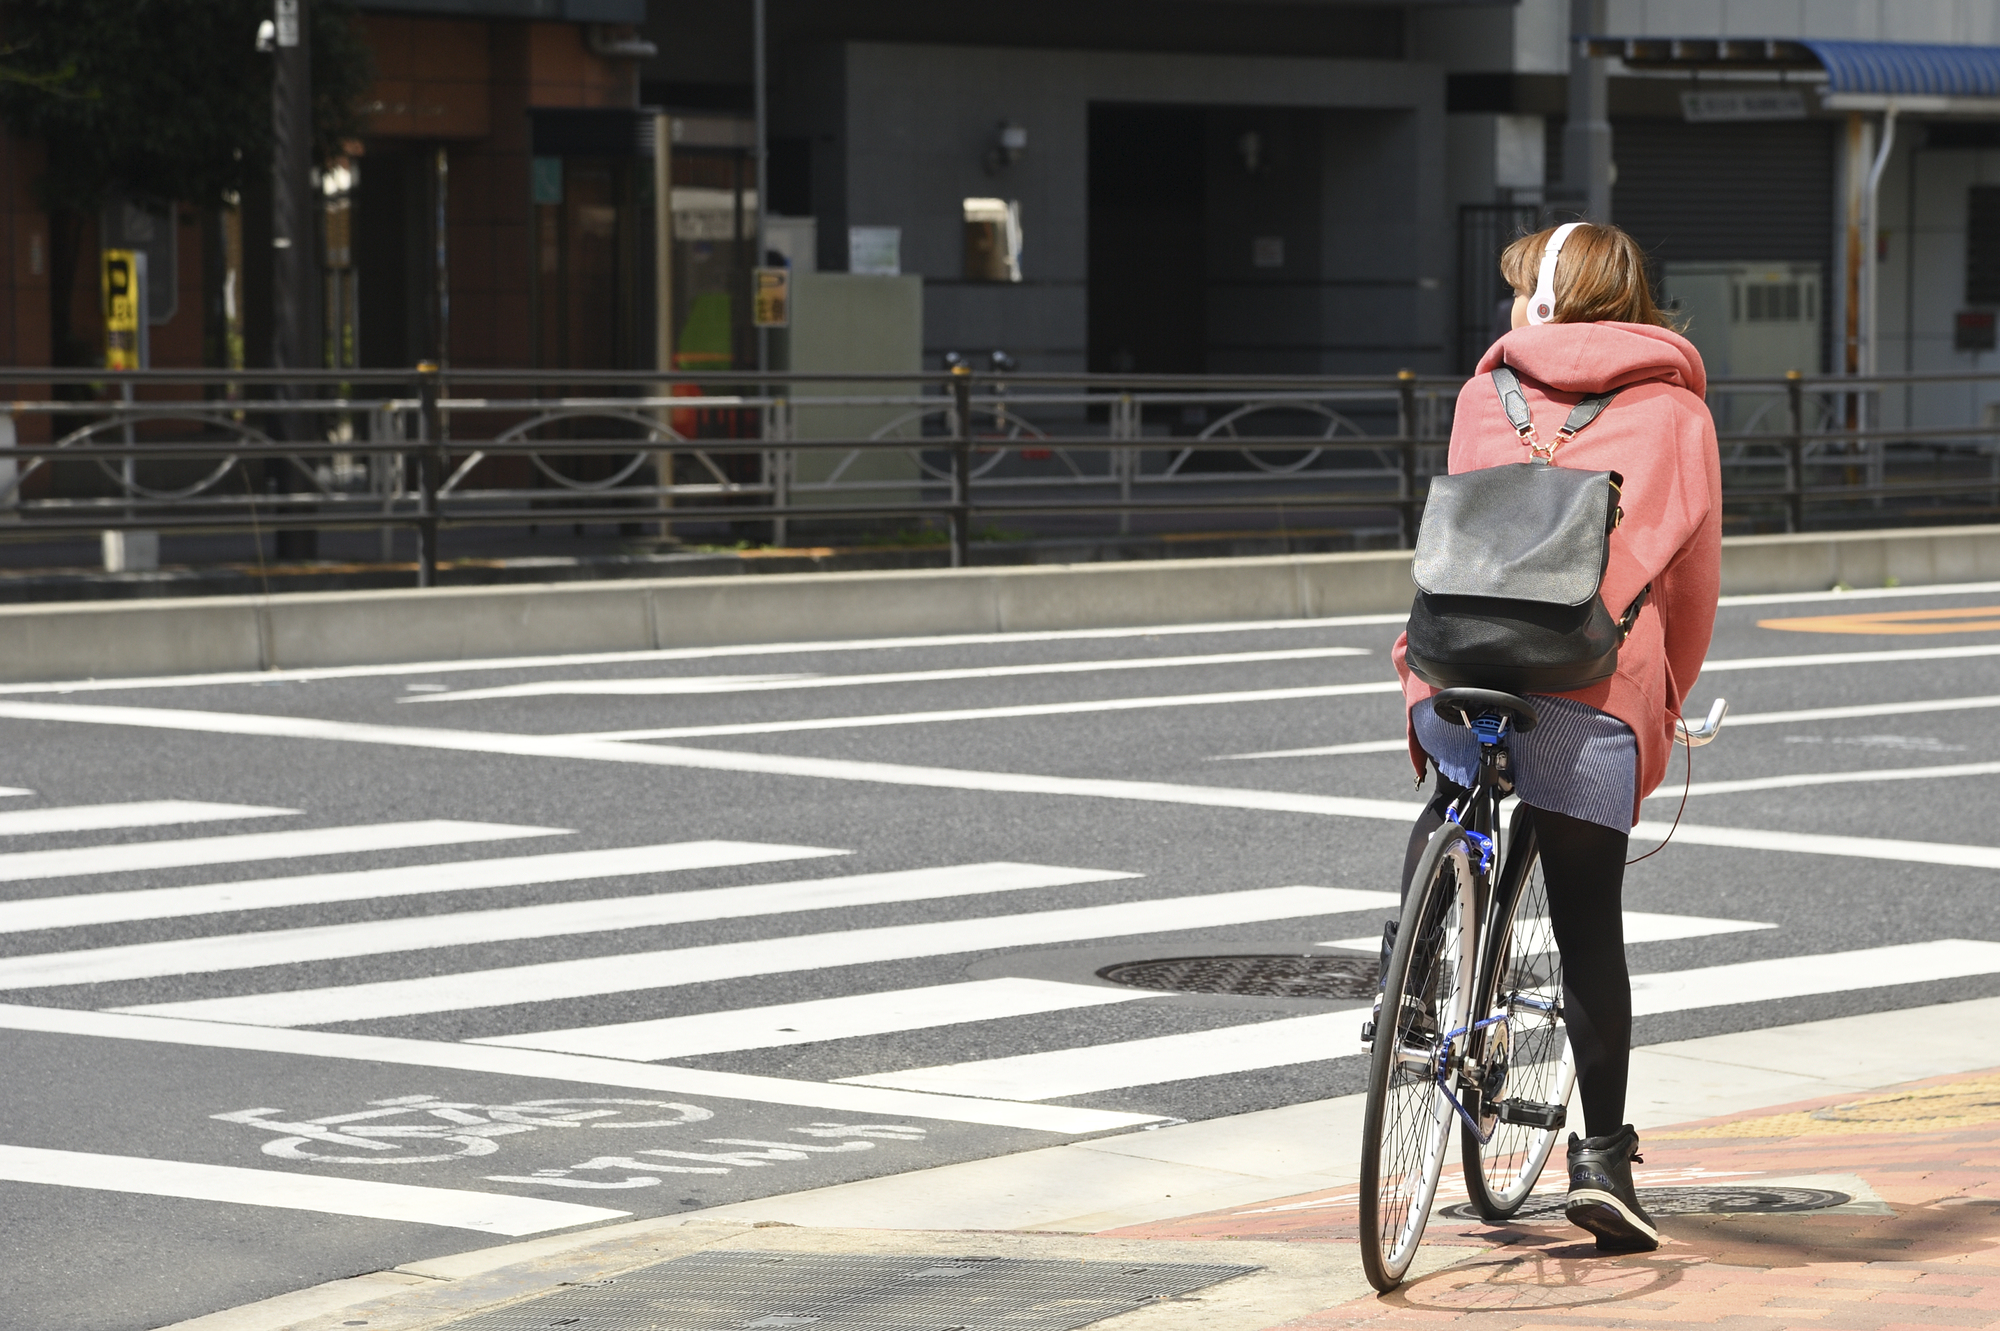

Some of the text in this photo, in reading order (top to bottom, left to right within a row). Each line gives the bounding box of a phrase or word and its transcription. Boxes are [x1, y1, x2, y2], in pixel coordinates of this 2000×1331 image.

[480, 1122, 927, 1189] じてんしゃ
